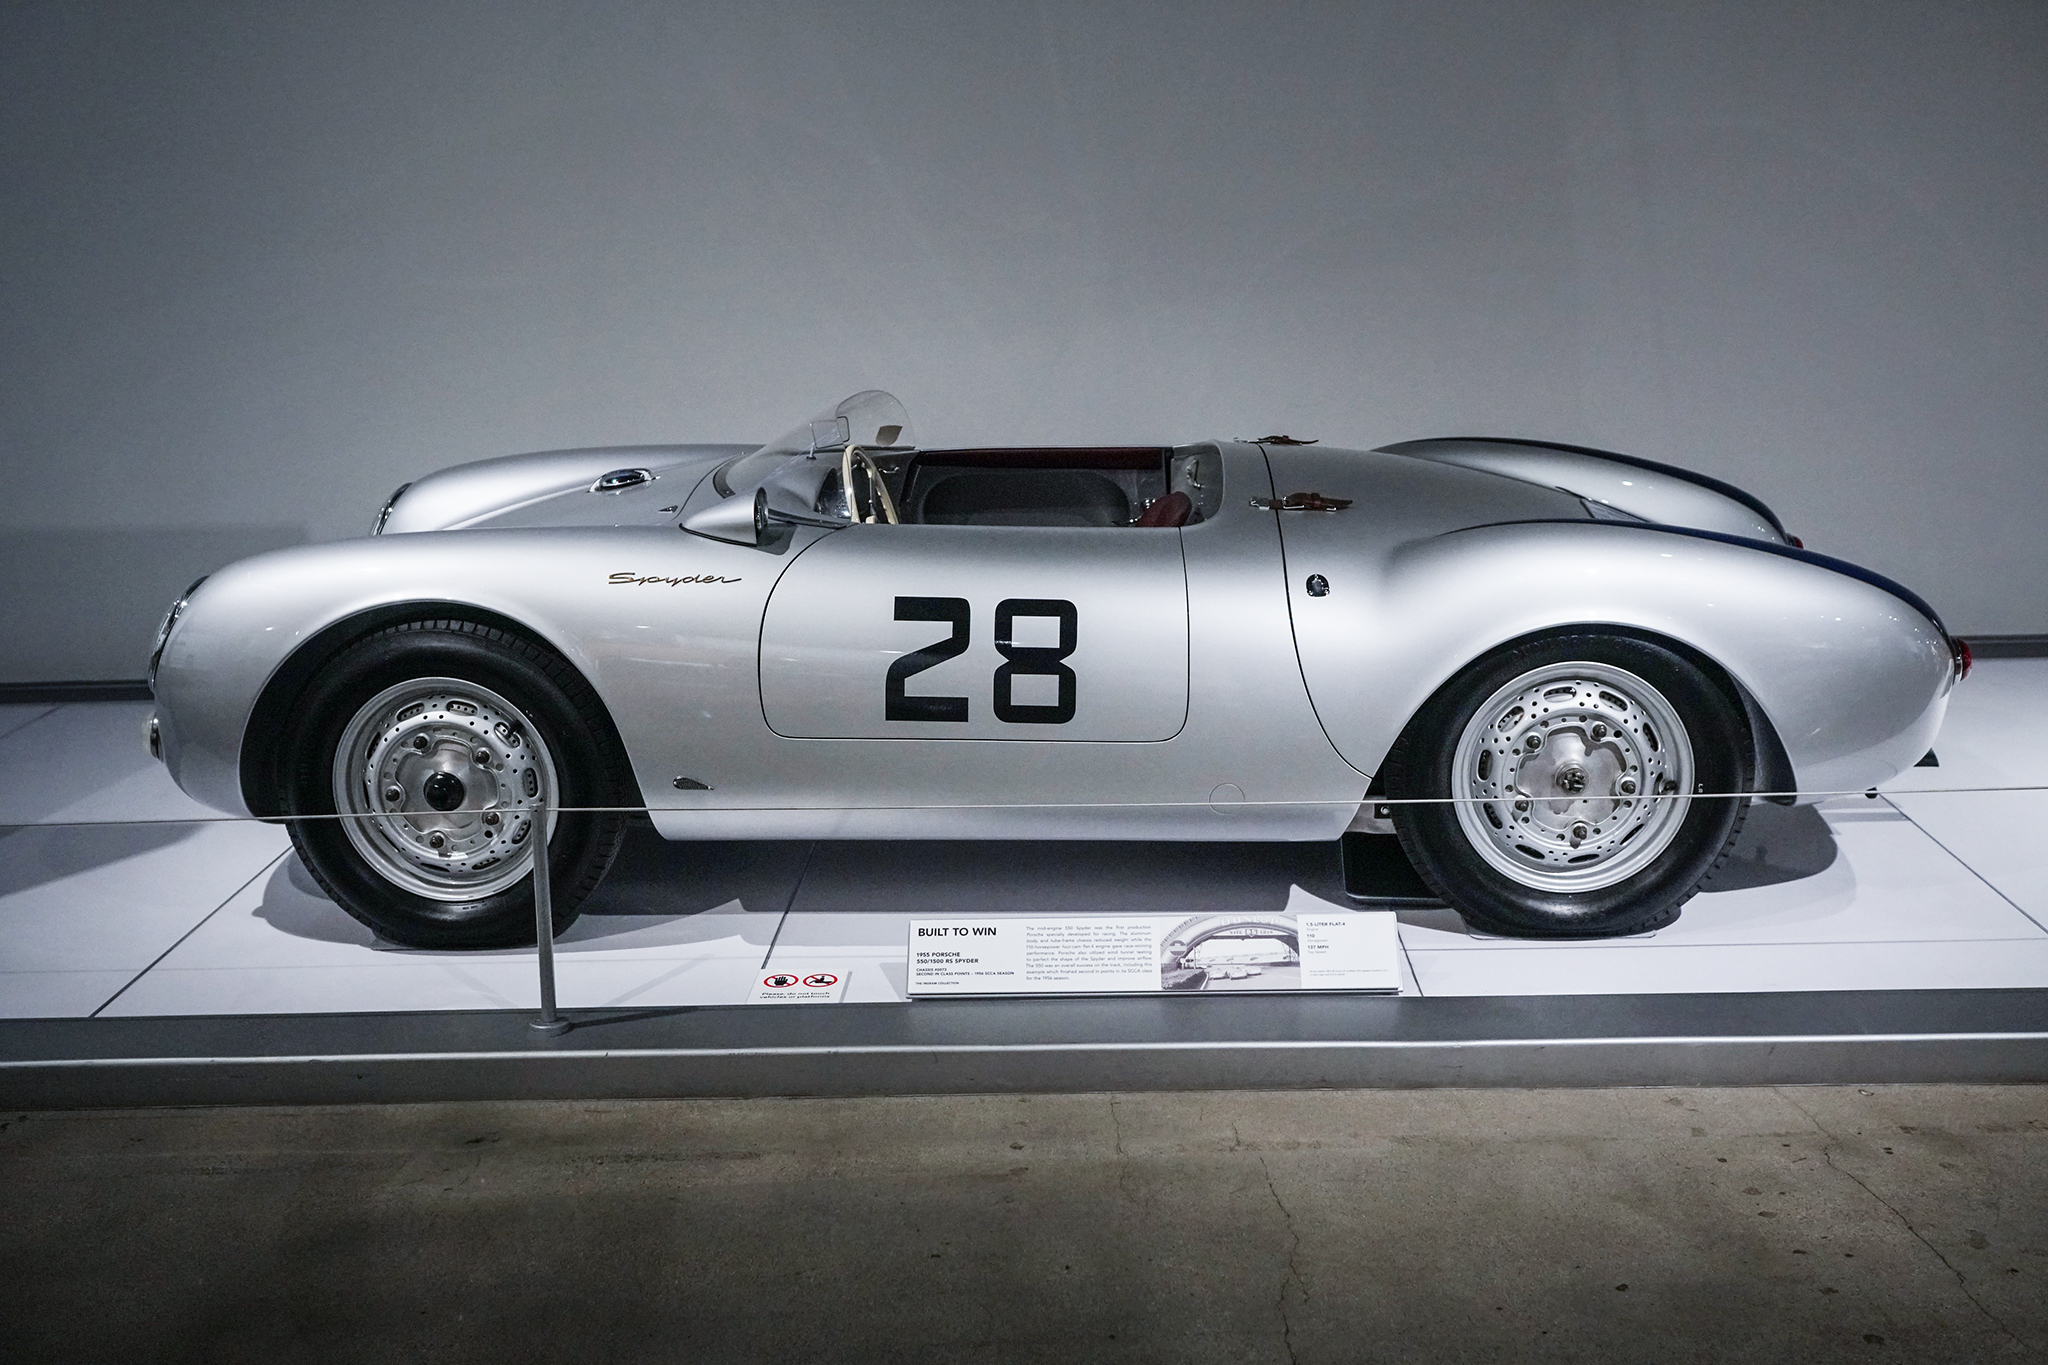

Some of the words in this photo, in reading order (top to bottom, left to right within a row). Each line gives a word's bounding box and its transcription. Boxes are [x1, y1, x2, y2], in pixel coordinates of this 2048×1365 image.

[608, 572, 742, 587] Spyder
[885, 596, 1078, 724] 28
[1220, 916, 1279, 925] DUNLOP
[918, 928, 949, 936] BUILT
[953, 928, 968, 936] TO
